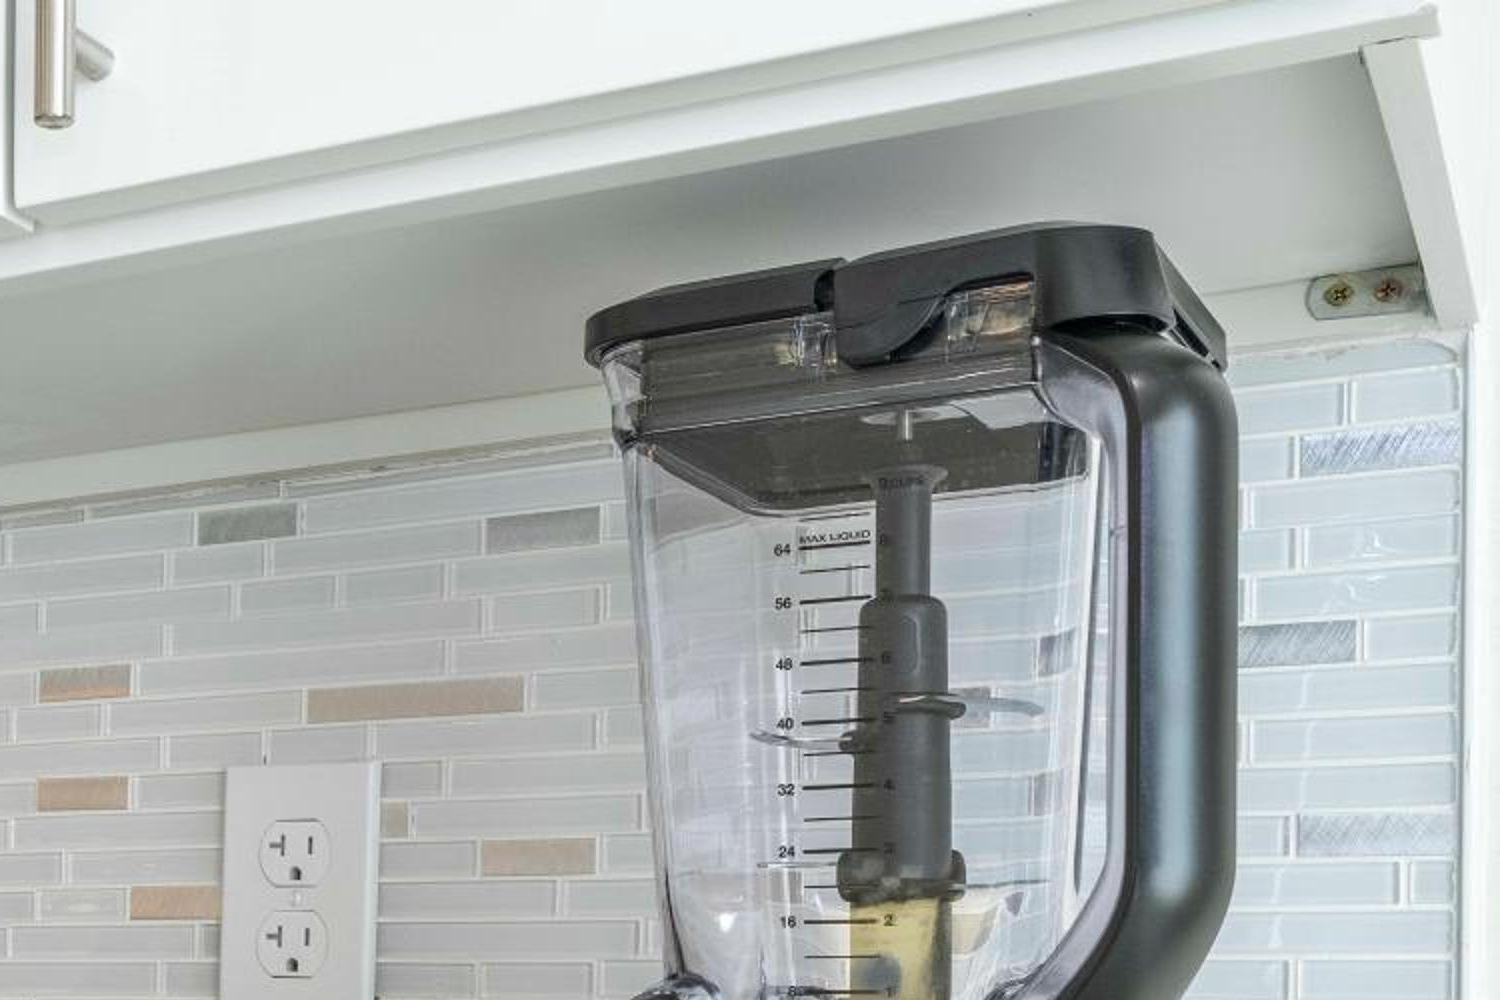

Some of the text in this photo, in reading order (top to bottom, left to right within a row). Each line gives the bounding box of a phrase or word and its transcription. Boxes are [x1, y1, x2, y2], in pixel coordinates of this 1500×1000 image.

[800, 530, 870, 544] MAX LIQUID
[774, 544, 791, 556] 64
[775, 597, 792, 610] 56
[776, 658, 793, 670] 48
[776, 718, 794, 730] 40
[778, 784, 795, 796] 32
[779, 846, 795, 858] 24
[781, 914, 895, 928] 16 2
